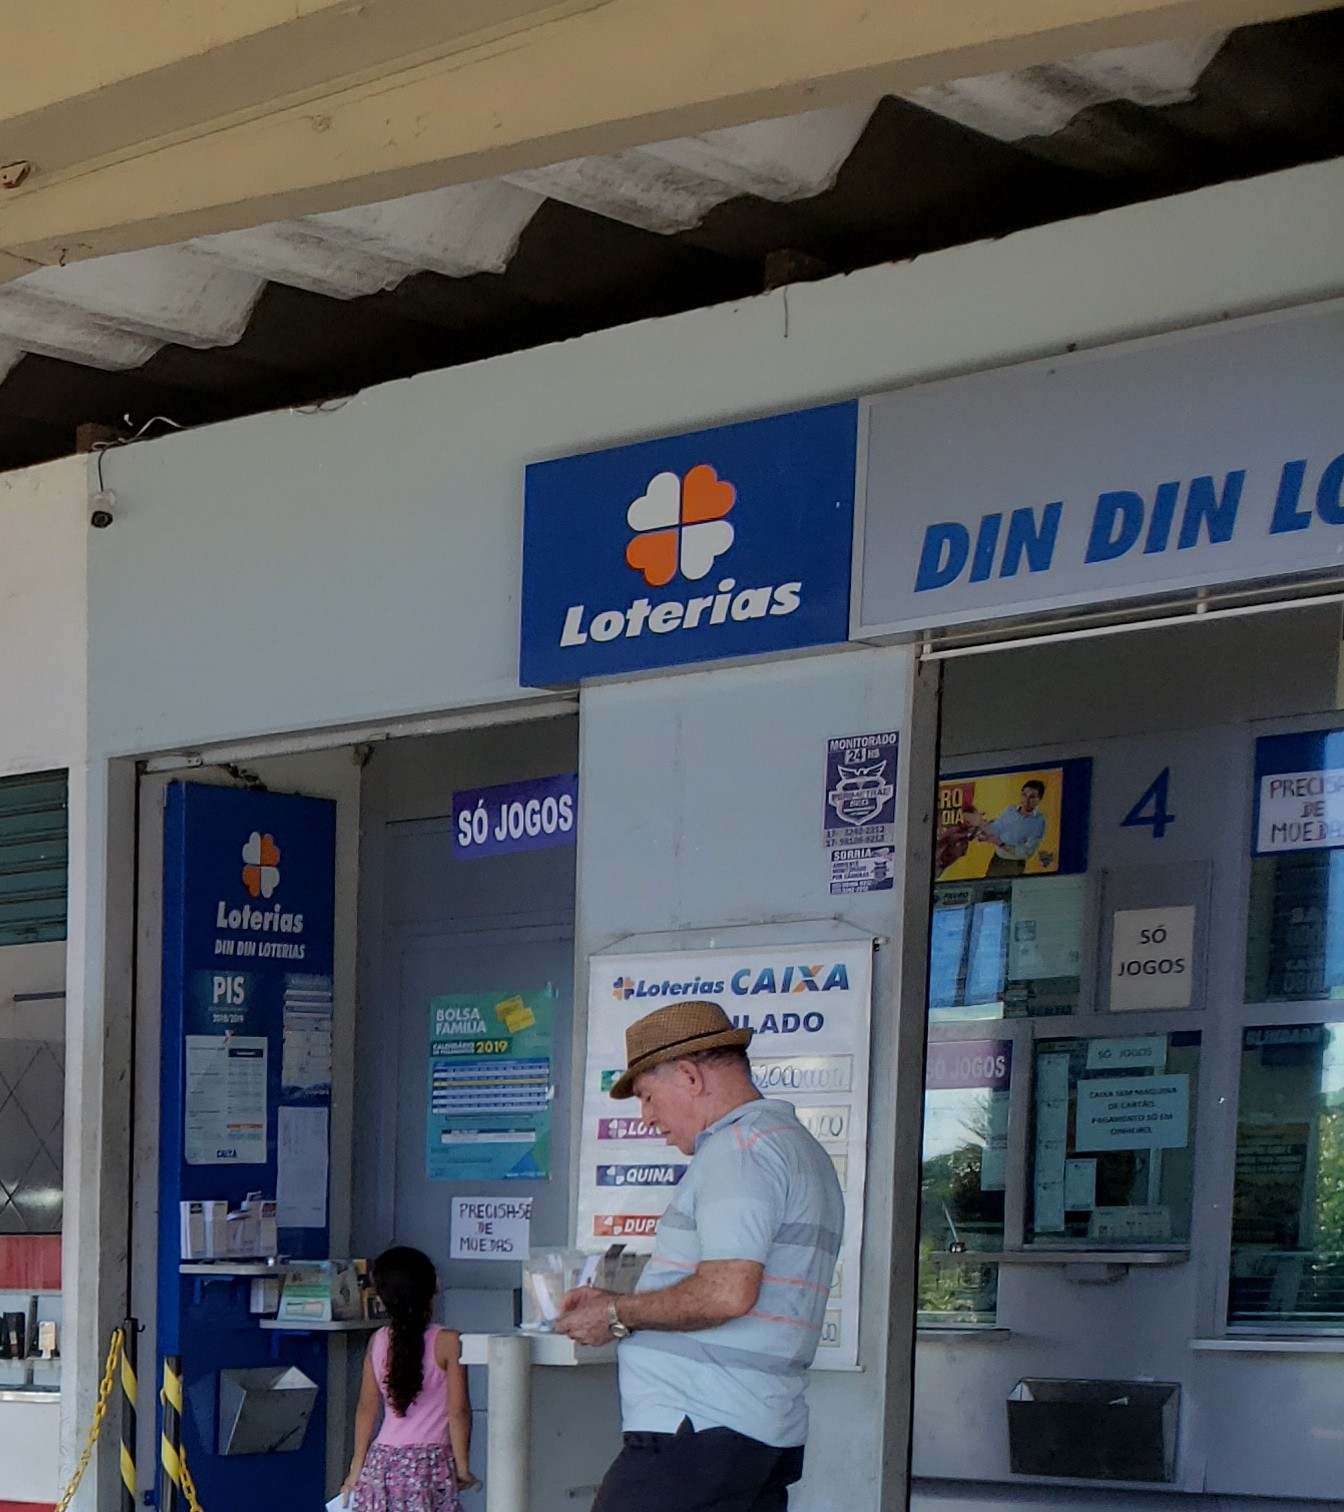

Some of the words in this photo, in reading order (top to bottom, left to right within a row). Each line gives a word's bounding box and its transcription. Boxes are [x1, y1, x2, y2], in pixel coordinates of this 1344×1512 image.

[914, 501, 1063, 593] DIN
[1084, 470, 1246, 564] DIN
[560, 578, 802, 647] Loterias
[830, 733, 897, 750] MONITORADO
[847, 750, 863, 763] 24
[1119, 766, 1175, 838] 4
[1300, 801, 1325, 818] DE
[458, 799, 488, 847] SÓ
[494, 794, 573, 841] JOGOS
[1272, 821, 1344, 844] MOEDA
[834, 848, 872, 861] SORRIA
[216, 901, 303, 933] Loterias
[1139, 924, 1167, 944] SÓ
[215, 938, 234, 955] DIN
[237, 940, 256, 957] DIN
[258, 942, 305, 959] LOTERIAS
[1118, 958, 1185, 977] JOGOS
[636, 976, 724, 998] Loterias
[730, 963, 850, 996] CAIXA
[213, 976, 245, 1005] PIS
[436, 1007, 480, 1022] BOLSA
[476, 1040, 508, 1054] 2019
[951, 1055, 1005, 1079] JOGOS
[626, 1169, 674, 1182] QUINA
[459, 1203, 531, 1220] PRECISA-SE
[478, 1221, 493, 1235] DE
[459, 1236, 513, 1253] MOEDAS
